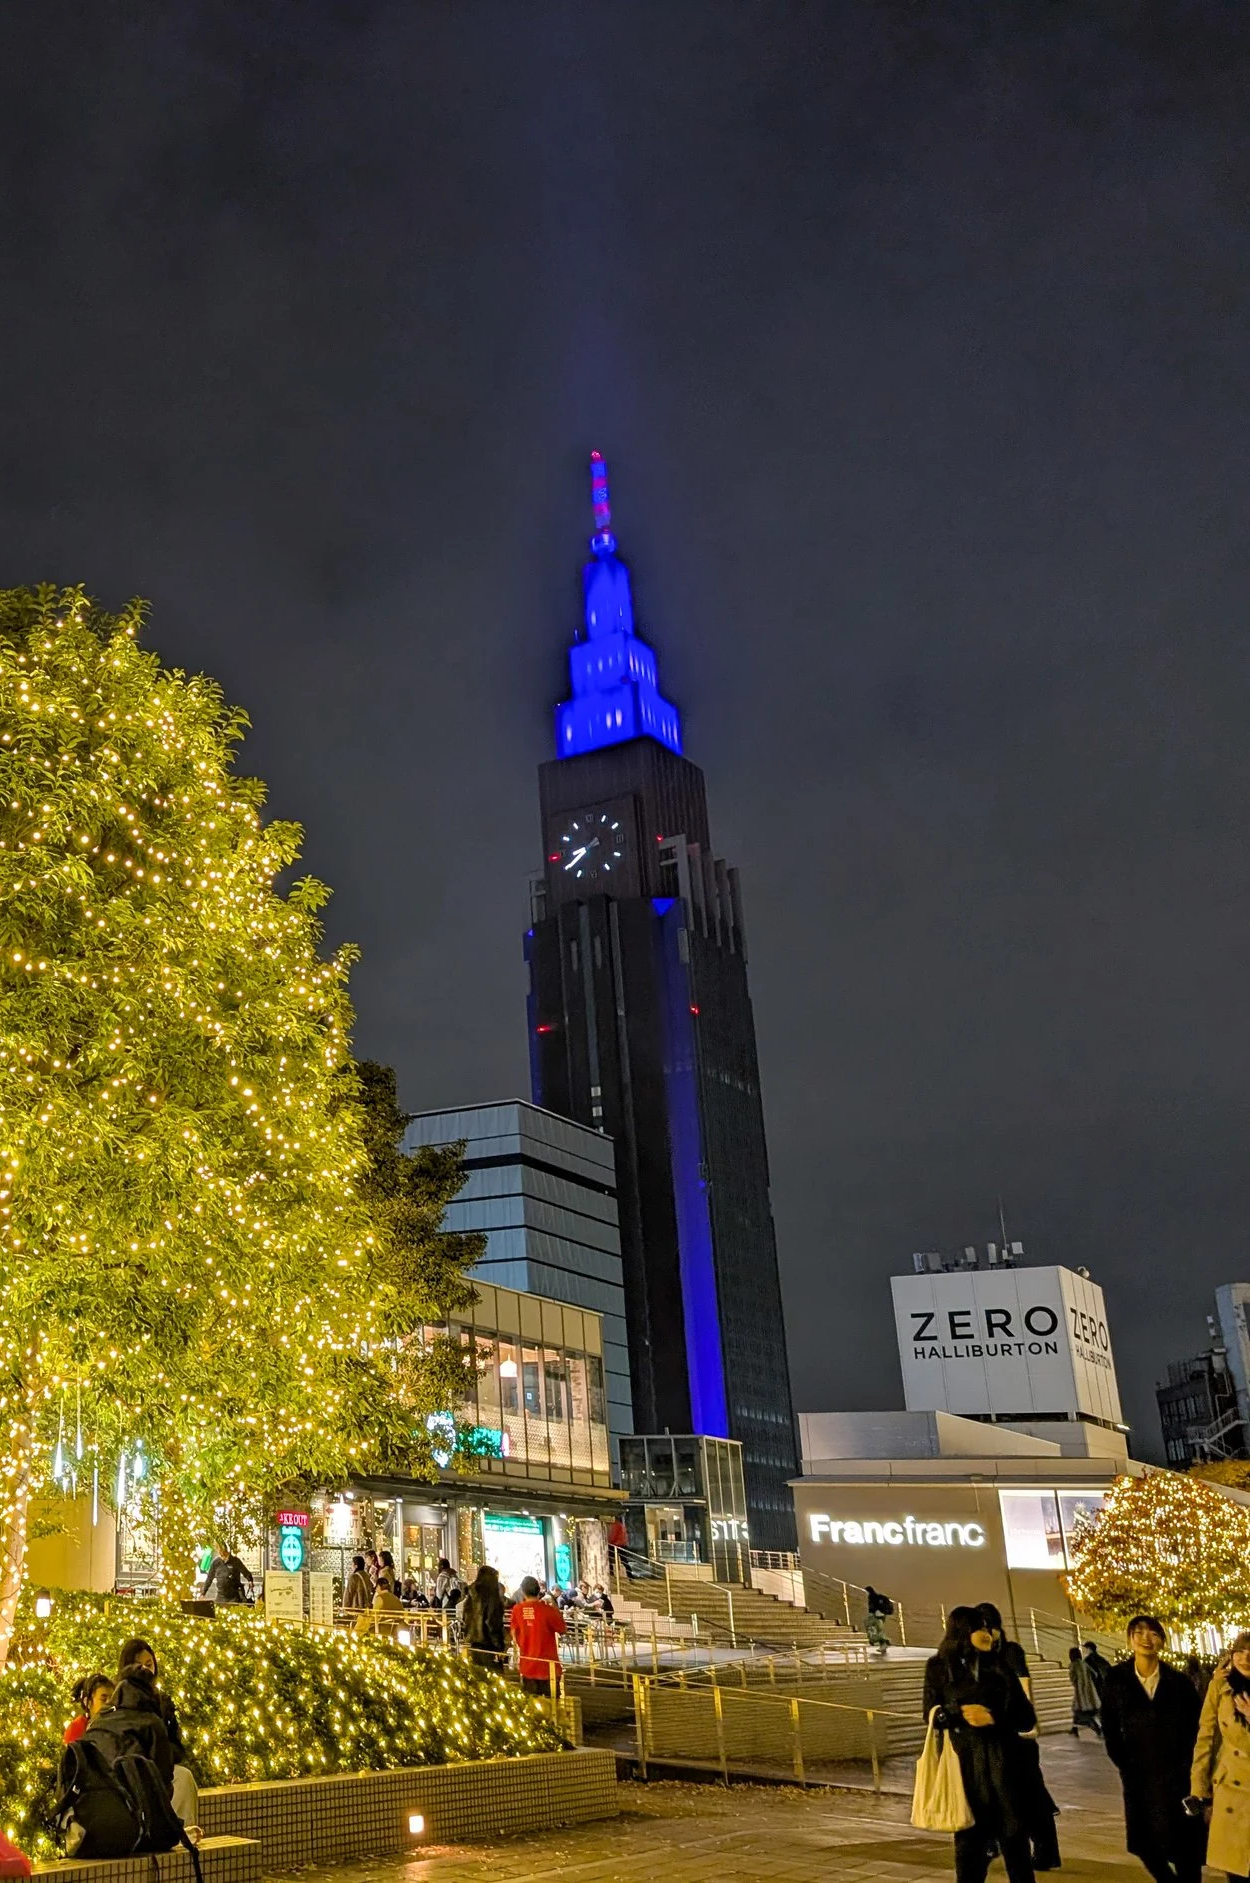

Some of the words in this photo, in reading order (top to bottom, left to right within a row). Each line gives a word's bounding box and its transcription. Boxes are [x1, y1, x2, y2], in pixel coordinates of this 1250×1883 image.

[910, 1306, 1059, 1342] ZERO
[1069, 1307, 1109, 1351] ZERO
[913, 1341, 1059, 1360] HALLIBURTON
[1075, 1344, 1113, 1370] HALLIBURTON
[808, 1513, 985, 1547] Francfranc
